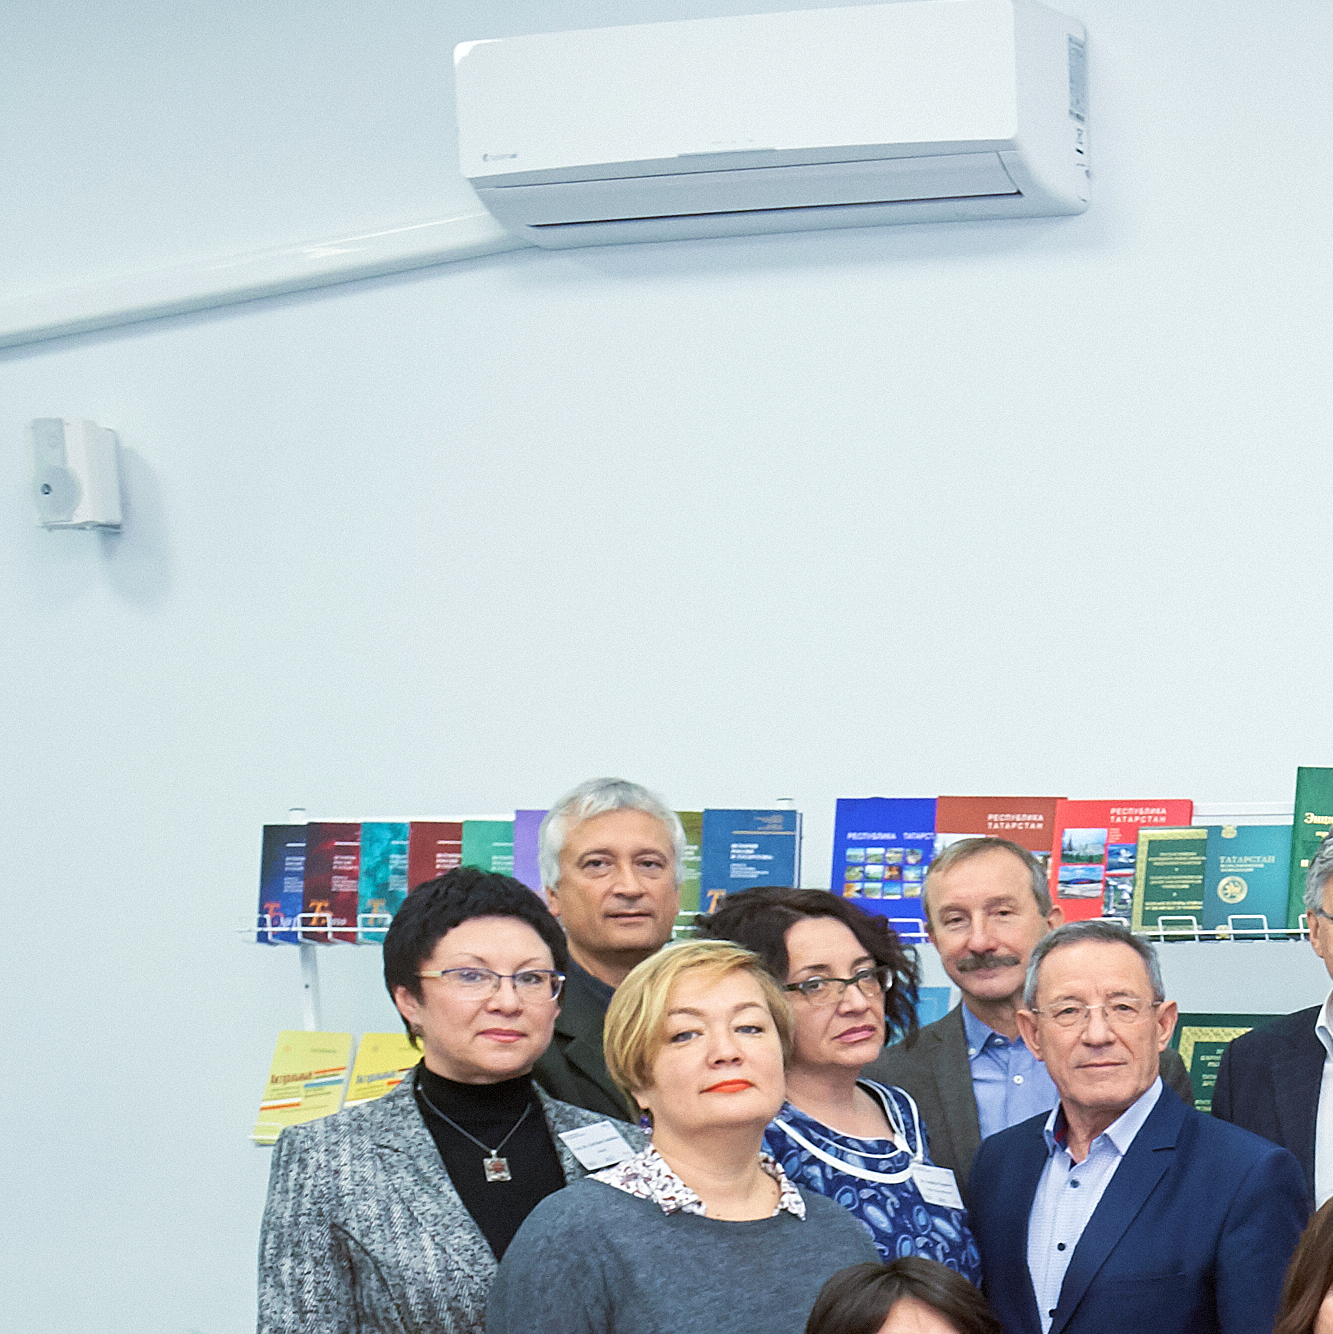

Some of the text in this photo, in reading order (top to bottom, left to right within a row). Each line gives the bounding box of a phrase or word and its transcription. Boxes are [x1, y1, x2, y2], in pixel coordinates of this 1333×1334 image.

[1110, 807, 1168, 815] РЕСПУБЛИКА
[987, 813, 1045, 822] РЕСПУБЛИКА
[1110, 815, 1167, 823] ТАТАРСТАН
[987, 822, 1044, 830] ТАТАРСТАН
[1219, 855, 1277, 864] ТАТАРСТАН
